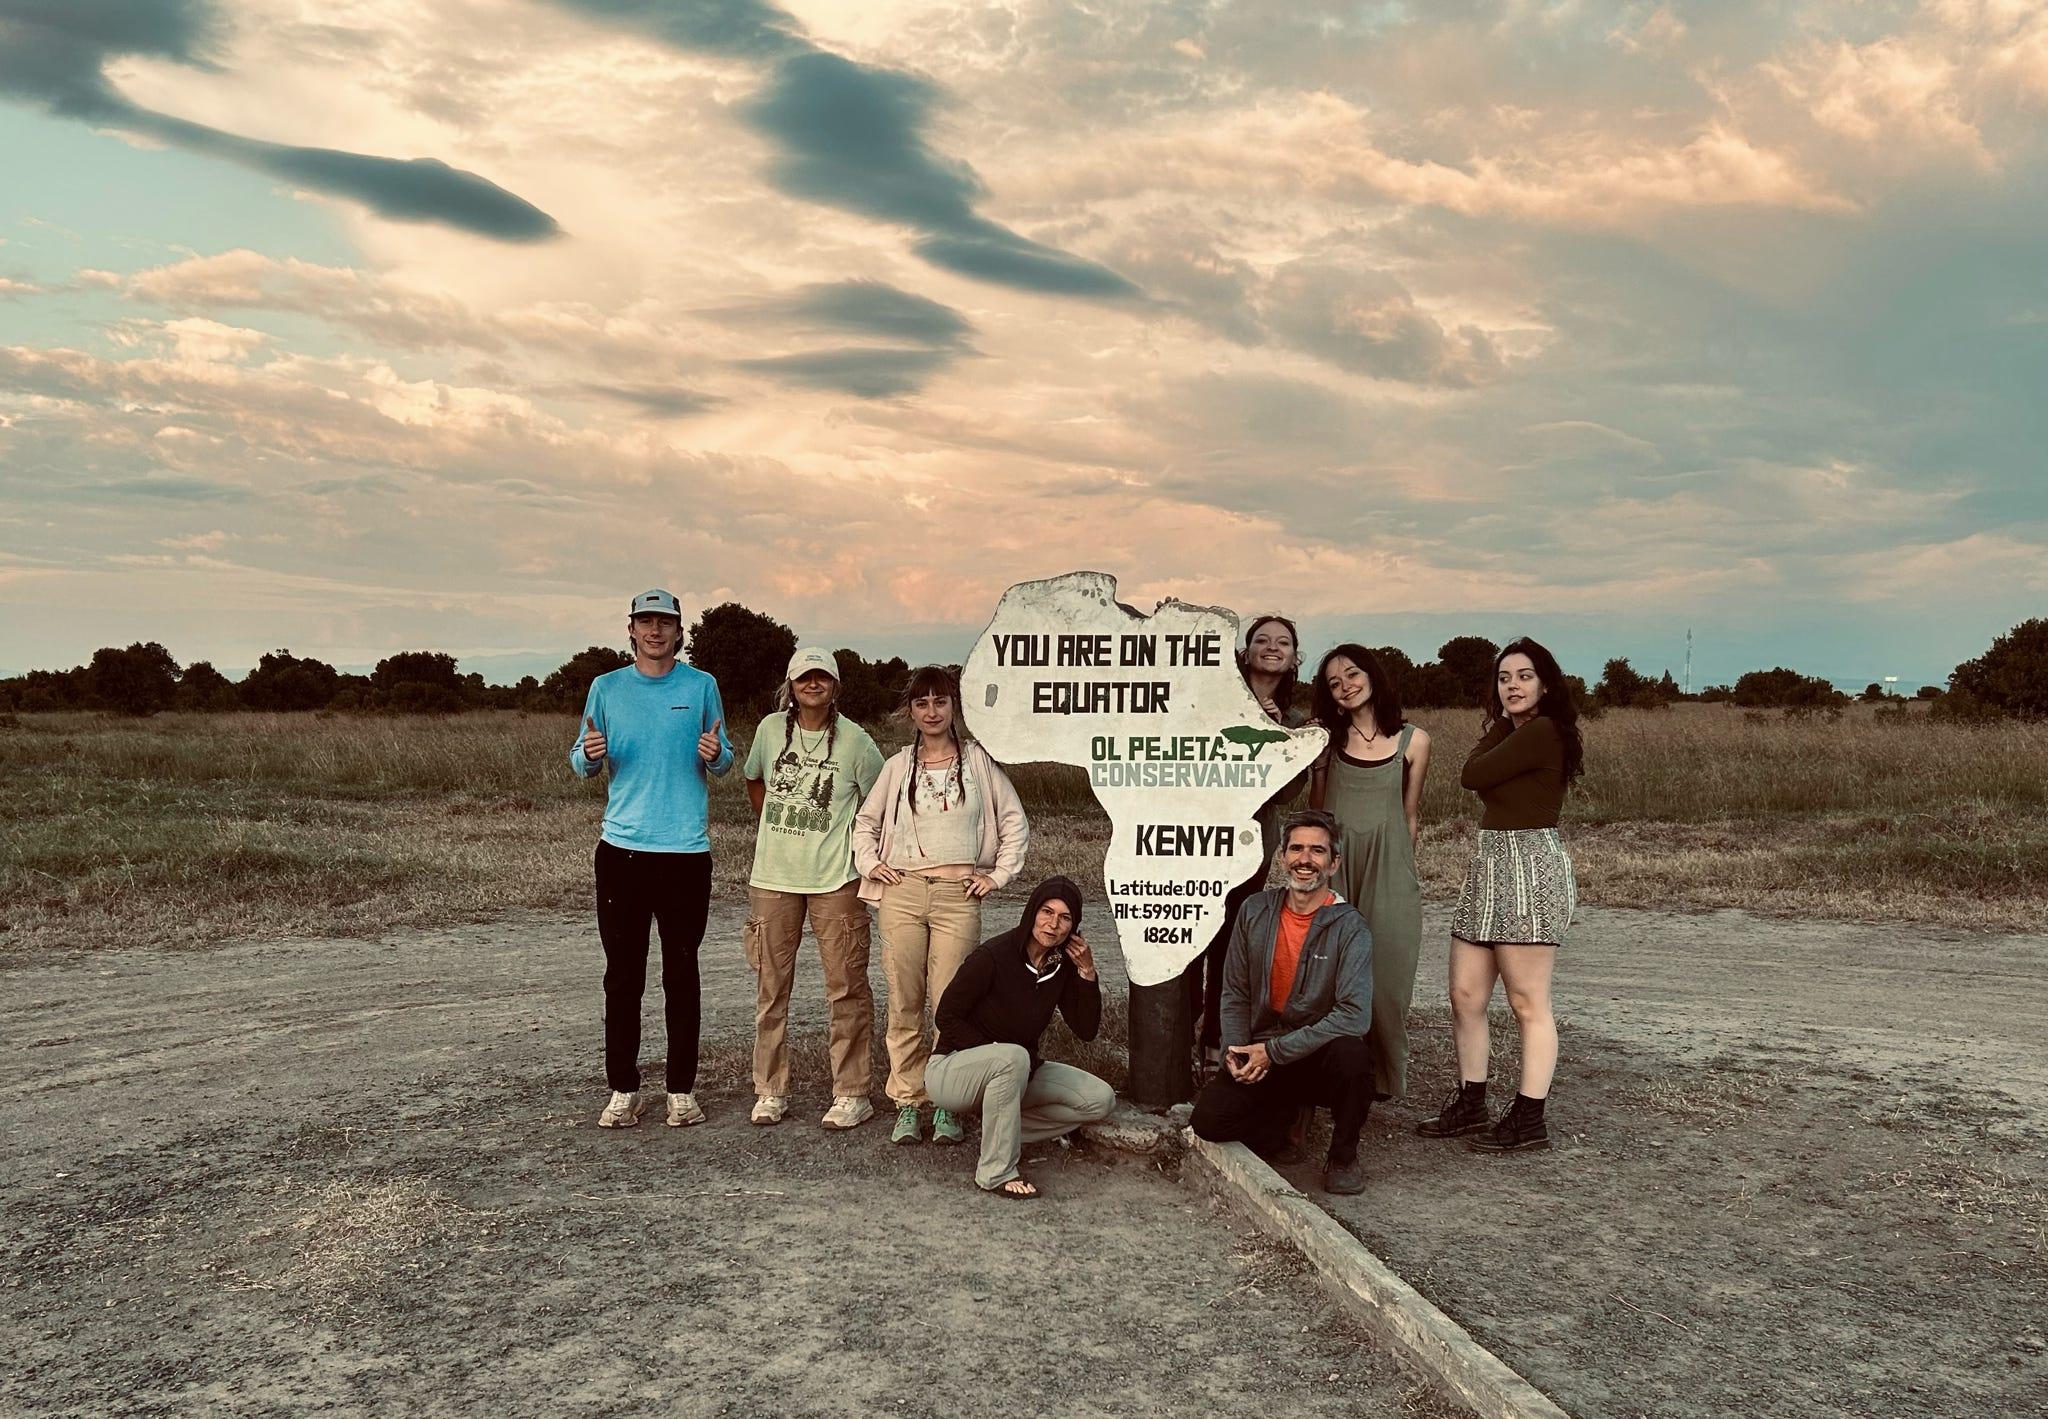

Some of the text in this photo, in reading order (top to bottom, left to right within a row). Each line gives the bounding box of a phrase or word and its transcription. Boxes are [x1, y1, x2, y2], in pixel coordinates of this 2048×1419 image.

[992, 634, 1221, 667] YOU ARE ON THE
[1033, 681, 1171, 715] EQUATOR
[1091, 736, 1122, 761] OL
[1091, 762, 1273, 788] CONSERVANCY
[1135, 824, 1235, 857] KENYA
